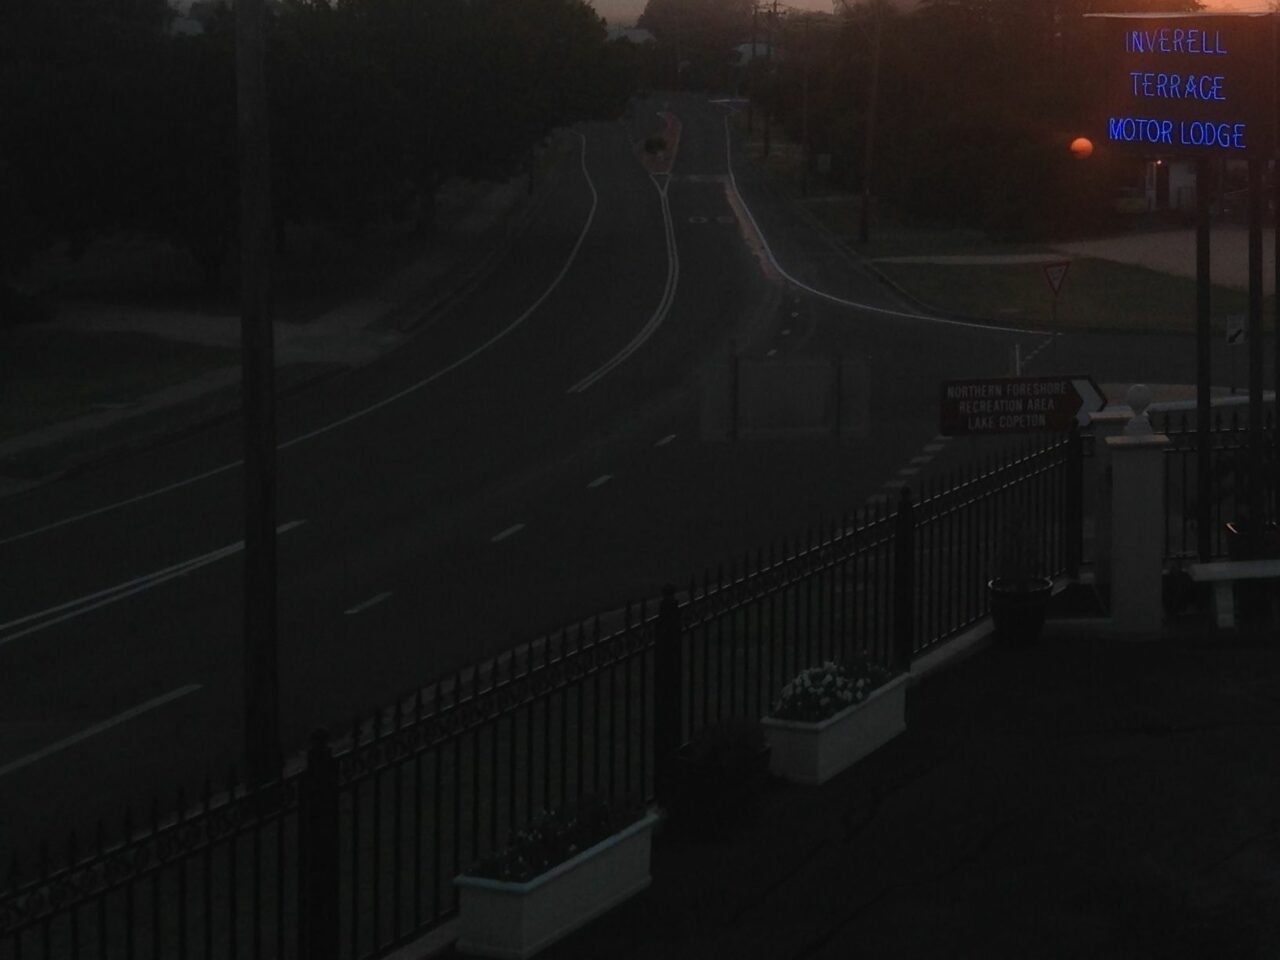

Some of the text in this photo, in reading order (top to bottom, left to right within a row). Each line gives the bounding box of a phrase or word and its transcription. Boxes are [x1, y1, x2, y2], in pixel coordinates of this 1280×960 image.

[1125, 28, 1228, 54] INVERELL
[1130, 72, 1226, 100] TERRACE
[1108, 117, 1247, 150] MOTOR LODGE
[947, 381, 1067, 399] NORTHERN FORESHORE
[959, 397, 1055, 414] RECREATION AREA
[968, 413, 1046, 430] LAKE COPETON
